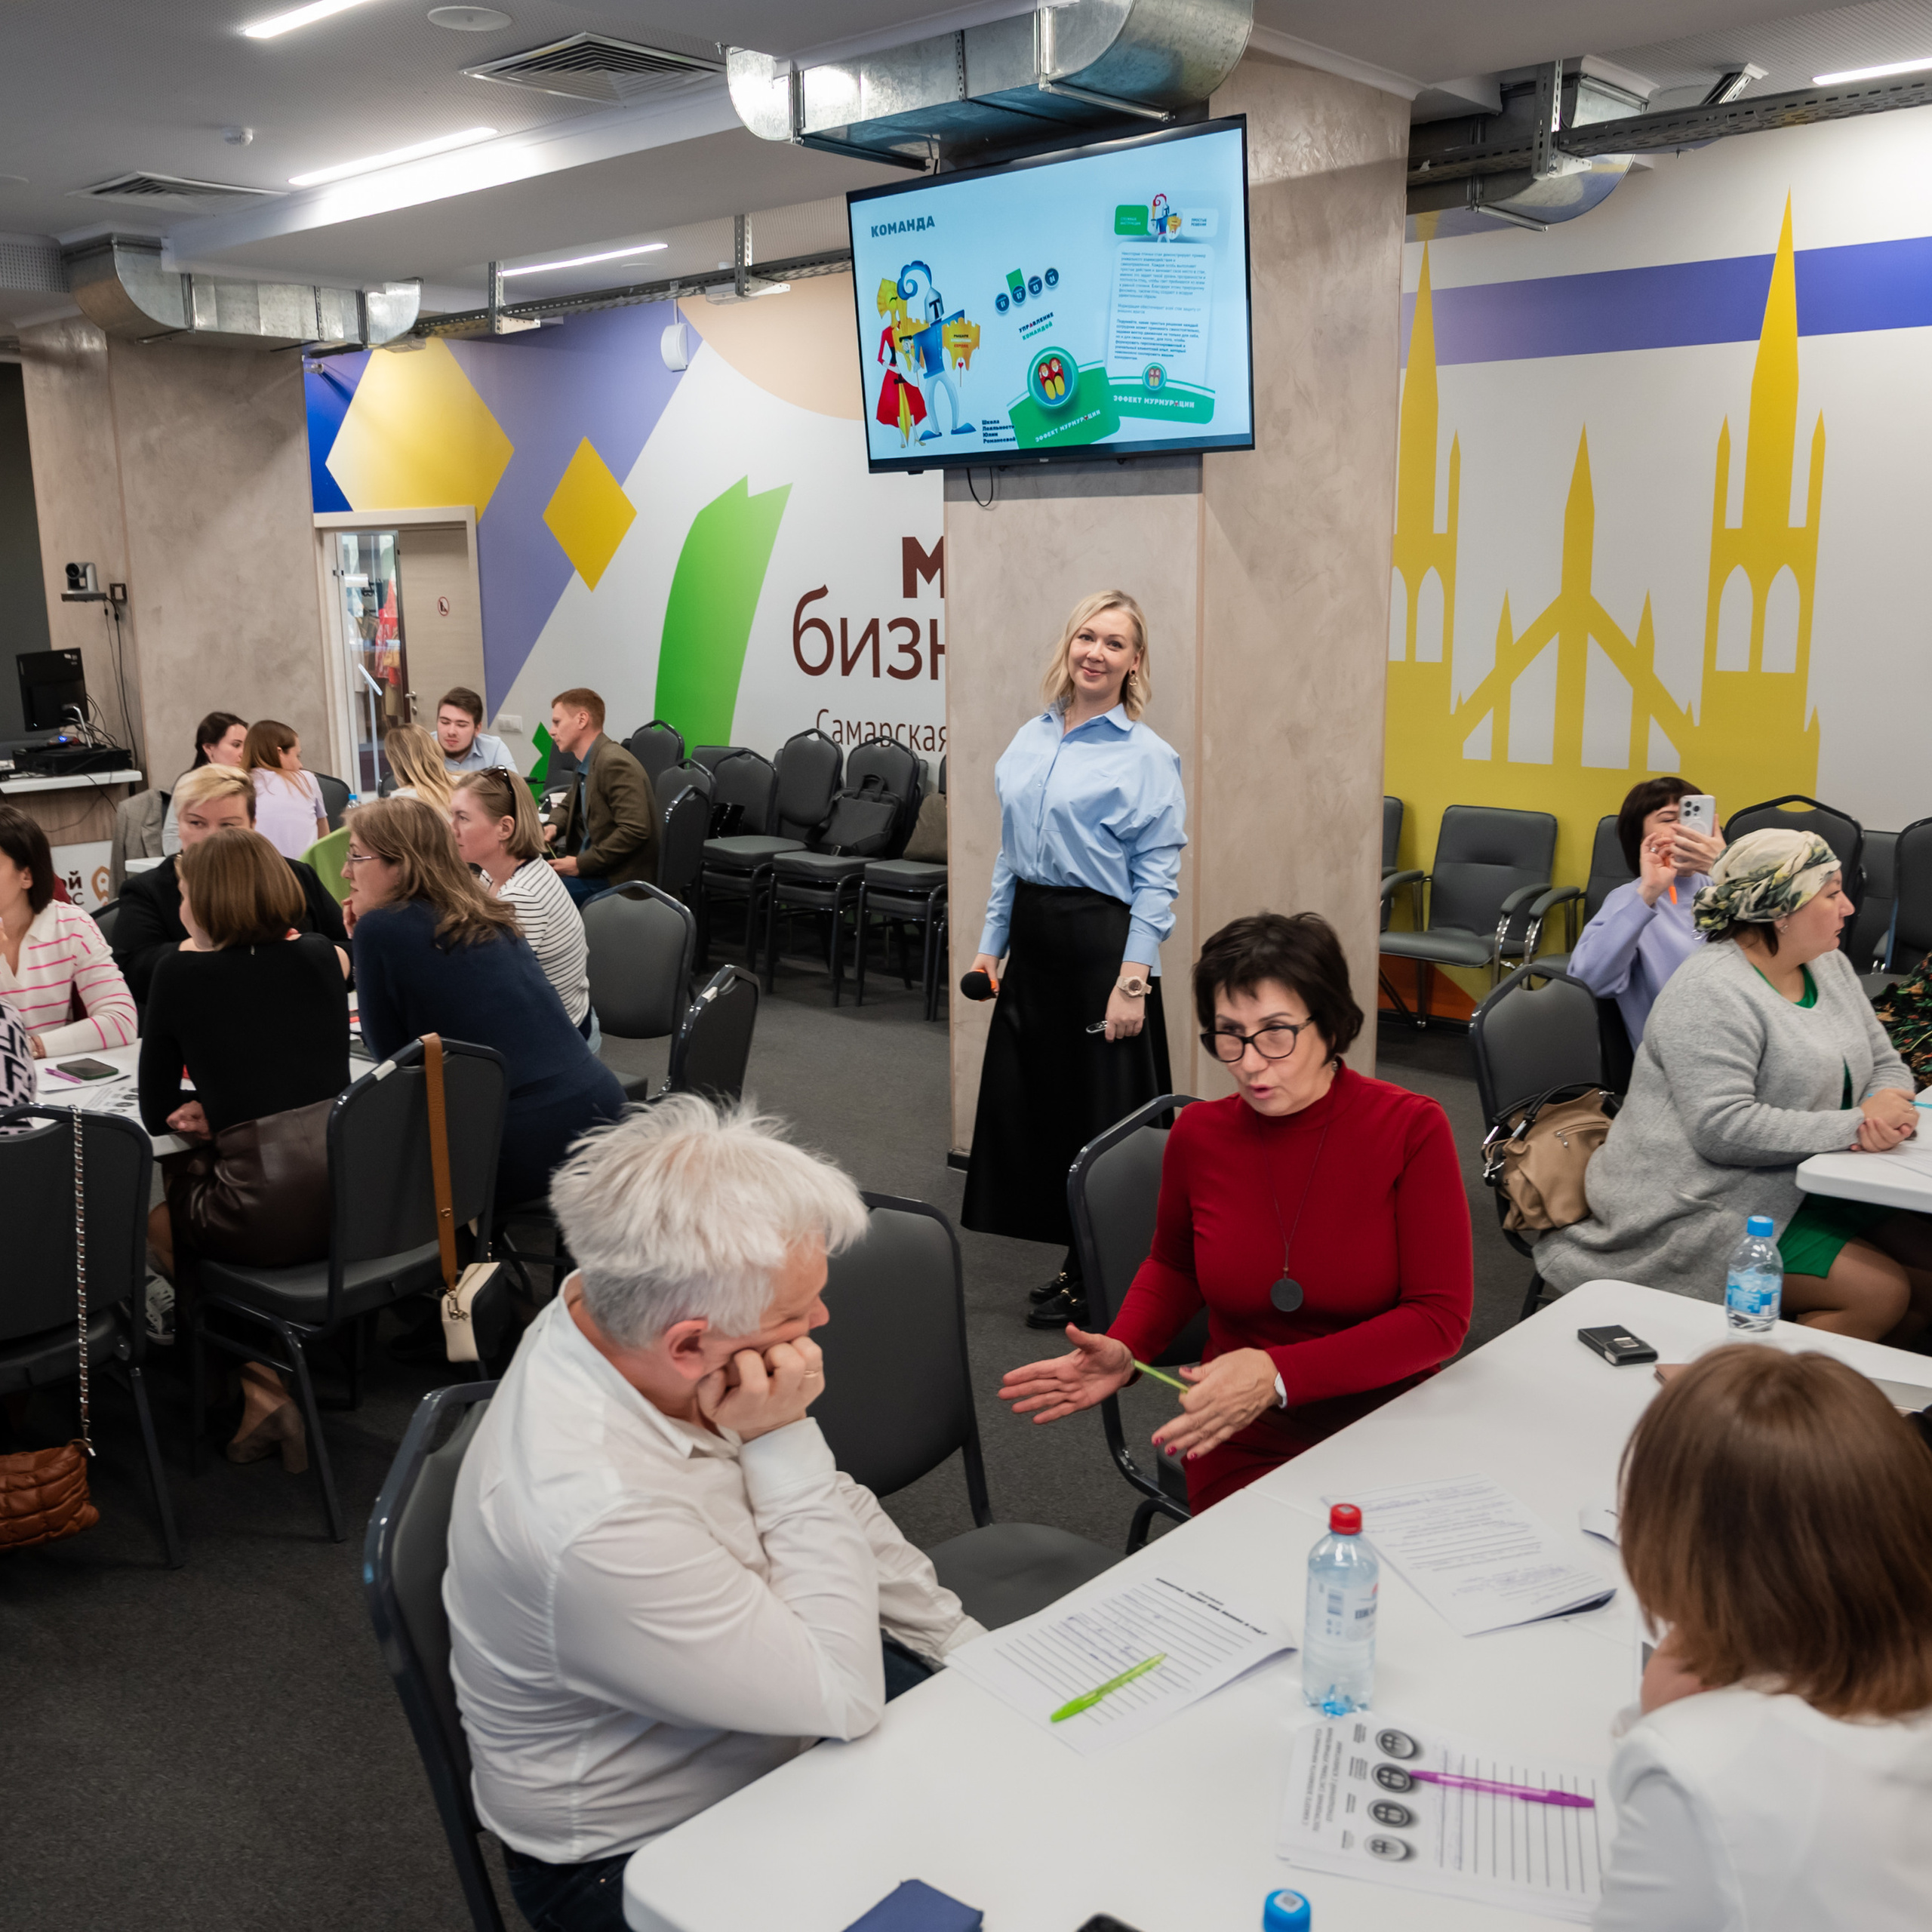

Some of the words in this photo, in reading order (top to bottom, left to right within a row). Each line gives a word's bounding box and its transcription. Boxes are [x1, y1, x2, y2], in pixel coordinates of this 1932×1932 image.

[871, 216, 935, 238] КОМАНДА
[1019, 312, 1054, 333] УПРАВЛЕНИЕ
[1023, 321, 1052, 340] КОМАНДОЙ
[1144, 398, 1195, 408] МУРМУРАЦИИ
[1035, 428, 1058, 442] ЭФФЕКТ
[1060, 409, 1100, 431] МУРМУРАЦИИ
